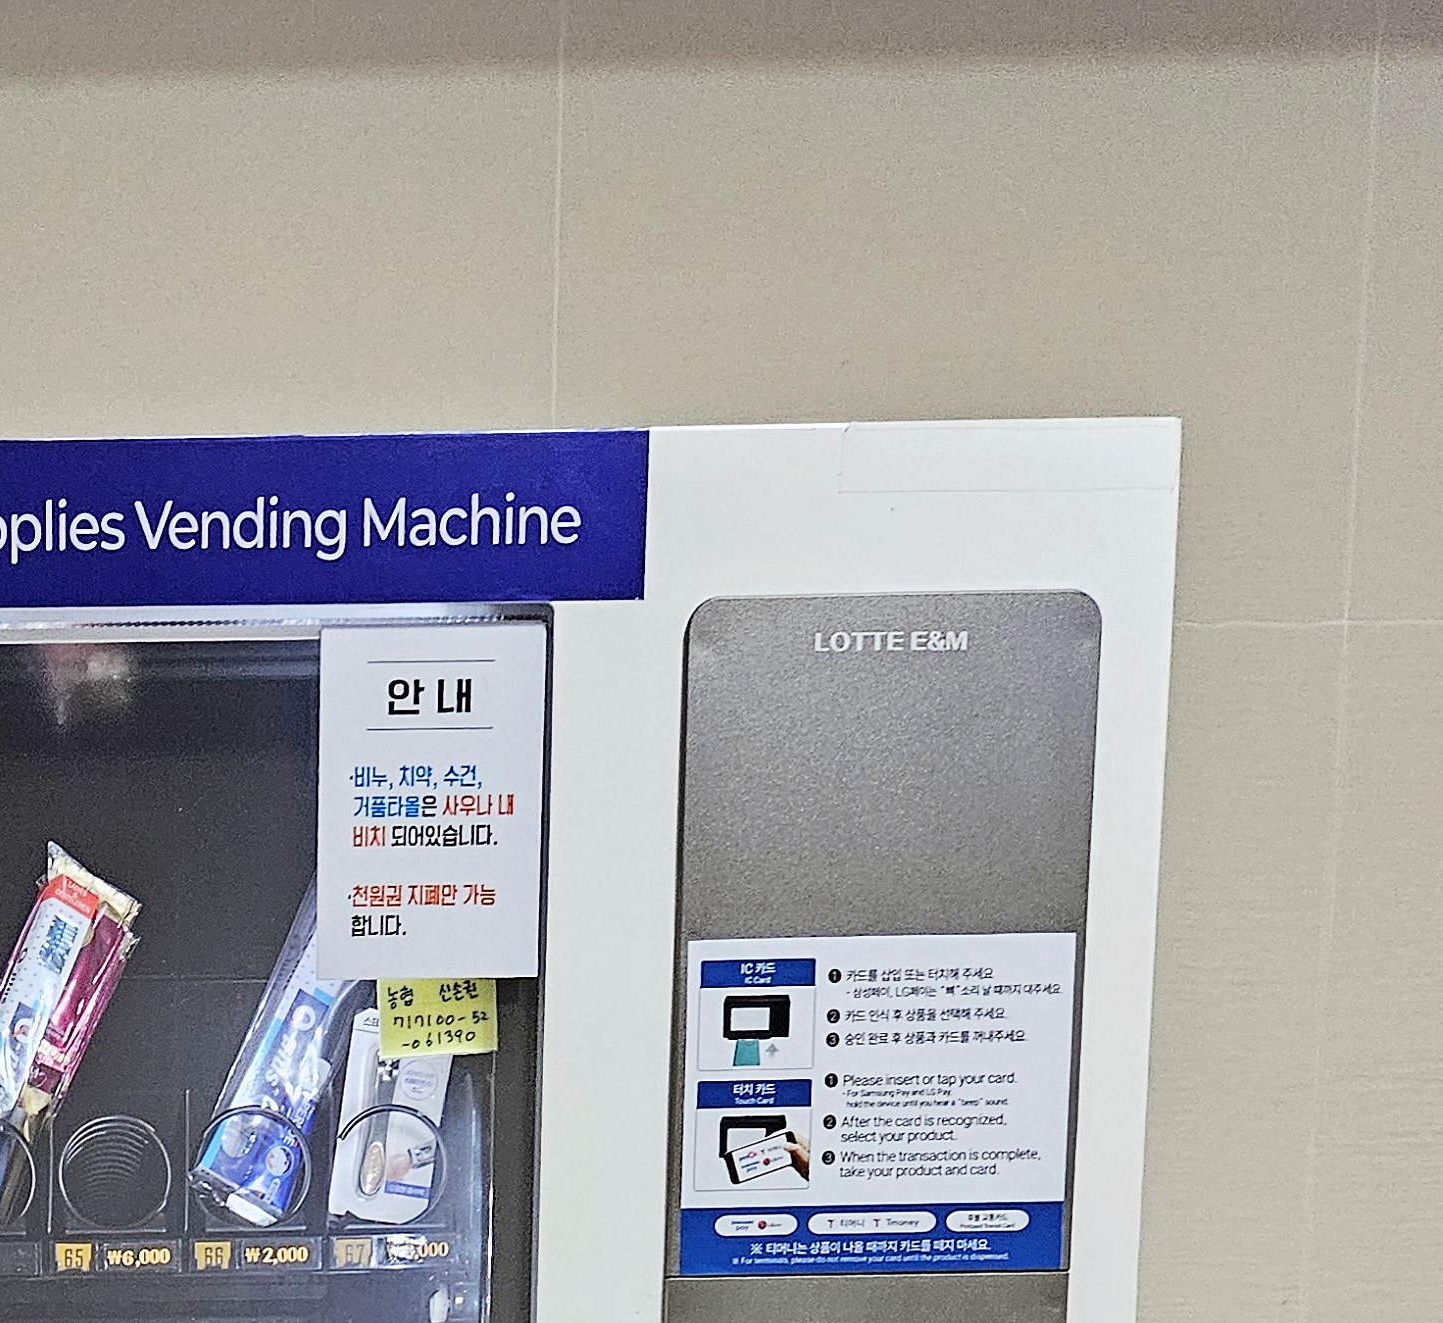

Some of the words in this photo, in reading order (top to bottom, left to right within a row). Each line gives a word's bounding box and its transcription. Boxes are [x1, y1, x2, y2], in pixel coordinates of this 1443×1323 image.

[134, 497, 347, 561] Vending
[357, 493, 583, 550] Machine
[814, 631, 904, 651] LOTTE
[910, 631, 968, 651] E&M
[399, 765, 438, 790] 치약,
[444, 764, 482, 790] 수건,
[353, 795, 437, 818] 거품타올은
[442, 794, 493, 817] 사우나
[498, 793, 514, 816] 내
[353, 826, 386, 847] 비치
[391, 825, 498, 847] 되어있습니다.
[407, 884, 457, 907] 지폐만
[463, 884, 495, 906] 가능
[351, 914, 407, 936] 합니다.
[741, 964, 753, 974] IC
[756, 963, 776, 974] 카드
[733, 1084, 753, 1096] 터치
[755, 1083, 776, 1095] 카드
[843, 1074, 883, 1086] Please
[886, 1074, 919, 1085] insert
[922, 1075, 935, 1085] or
[938, 1074, 956, 1087] tap
[959, 1075, 985, 1087] your
[841, 1116, 870, 1128] After
[874, 1115, 892, 1127] the
[895, 1114, 921, 1127] card
[925, 1115, 934, 1126] is
[841, 1132, 876, 1142] select
[879, 1132, 905, 1144] your
[841, 1151, 874, 1163] When
[877, 1151, 896, 1162] the
[898, 1150, 966, 1162] transaction
[969, 1150, 979, 1161] is
[840, 1167, 865, 1178] take
[867, 1167, 893, 1180] your
[896, 1165, 942, 1179] product
[945, 1164, 967, 1176] and
[105, 1247, 171, 1268] ₩6,000
[244, 1246, 309, 1266] ₩2,000
